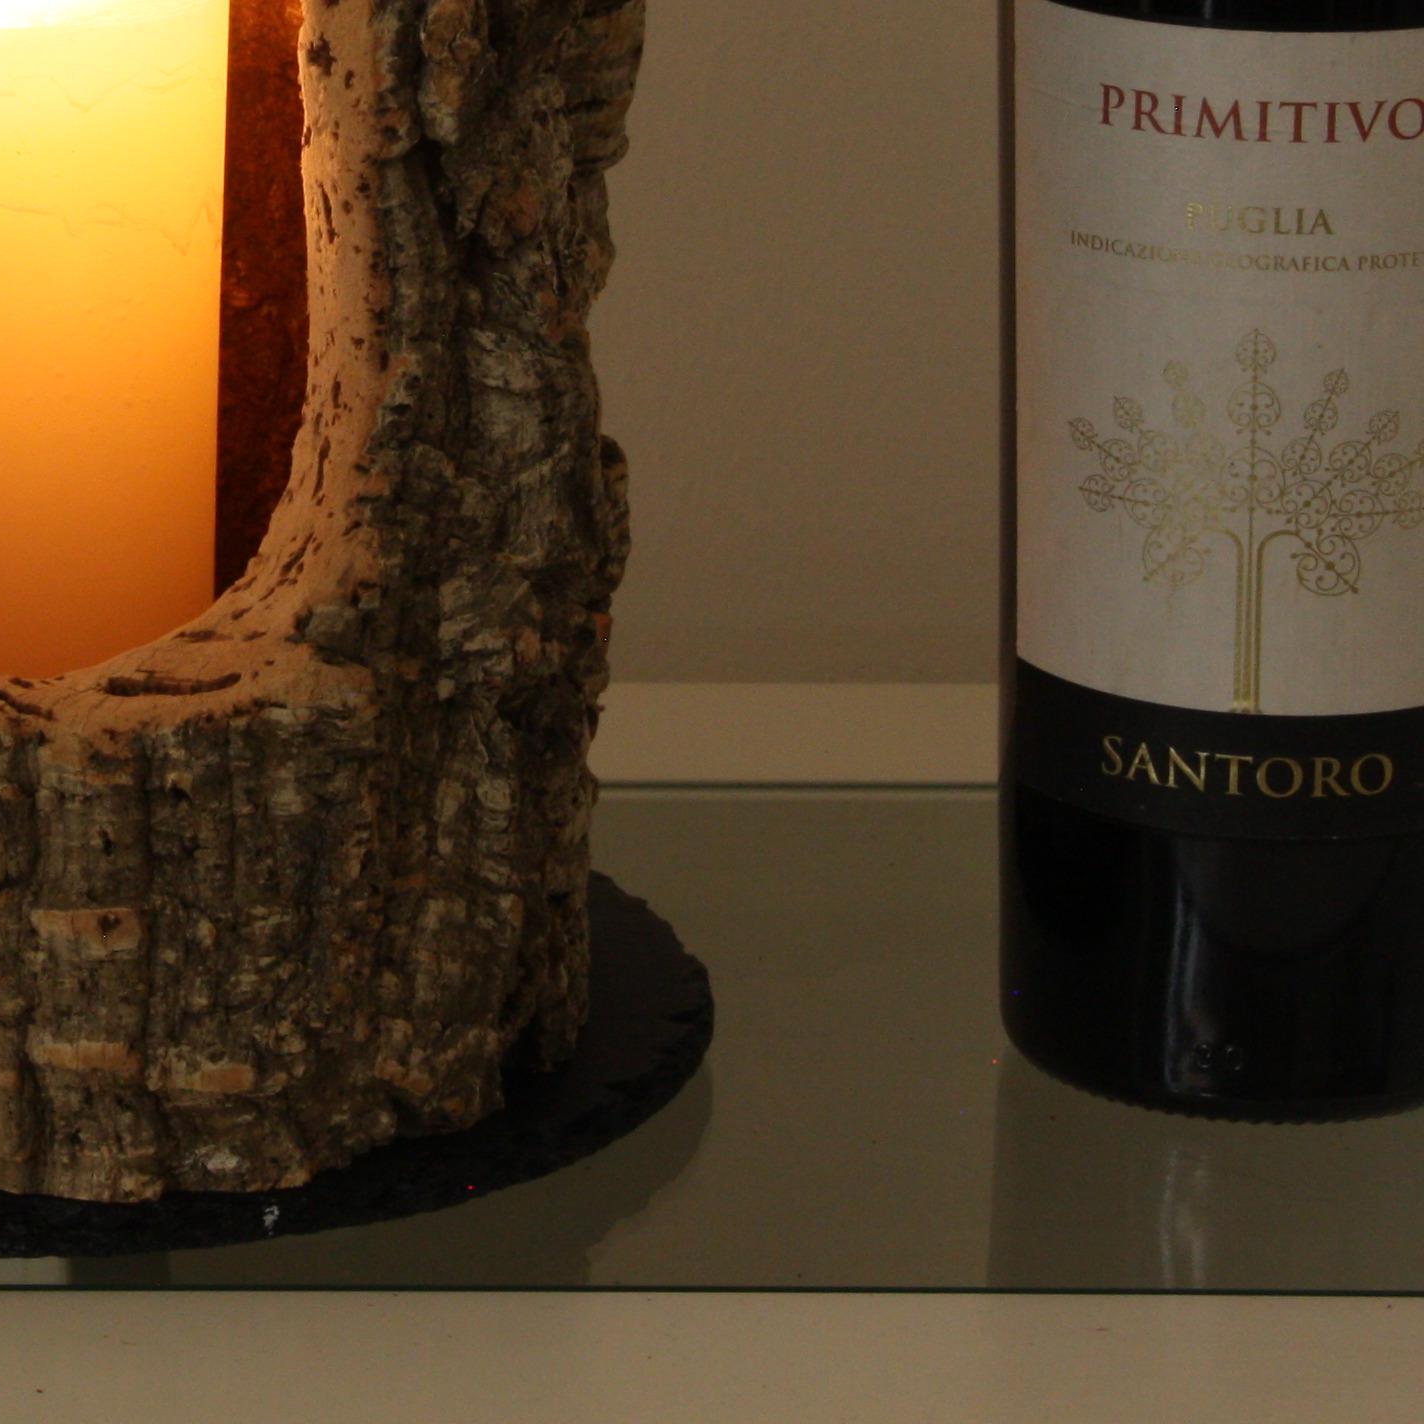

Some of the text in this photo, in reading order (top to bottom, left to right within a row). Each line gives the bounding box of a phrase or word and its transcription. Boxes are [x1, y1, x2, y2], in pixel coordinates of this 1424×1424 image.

[1098, 82, 1424, 143] PRIMITIVO
[1185, 200, 1336, 236] PUGLIA
[1070, 230, 1200, 265] INDICAZIO
[1208, 253, 1350, 273] OGRAFICA
[1100, 734, 1395, 799] SANTORO
